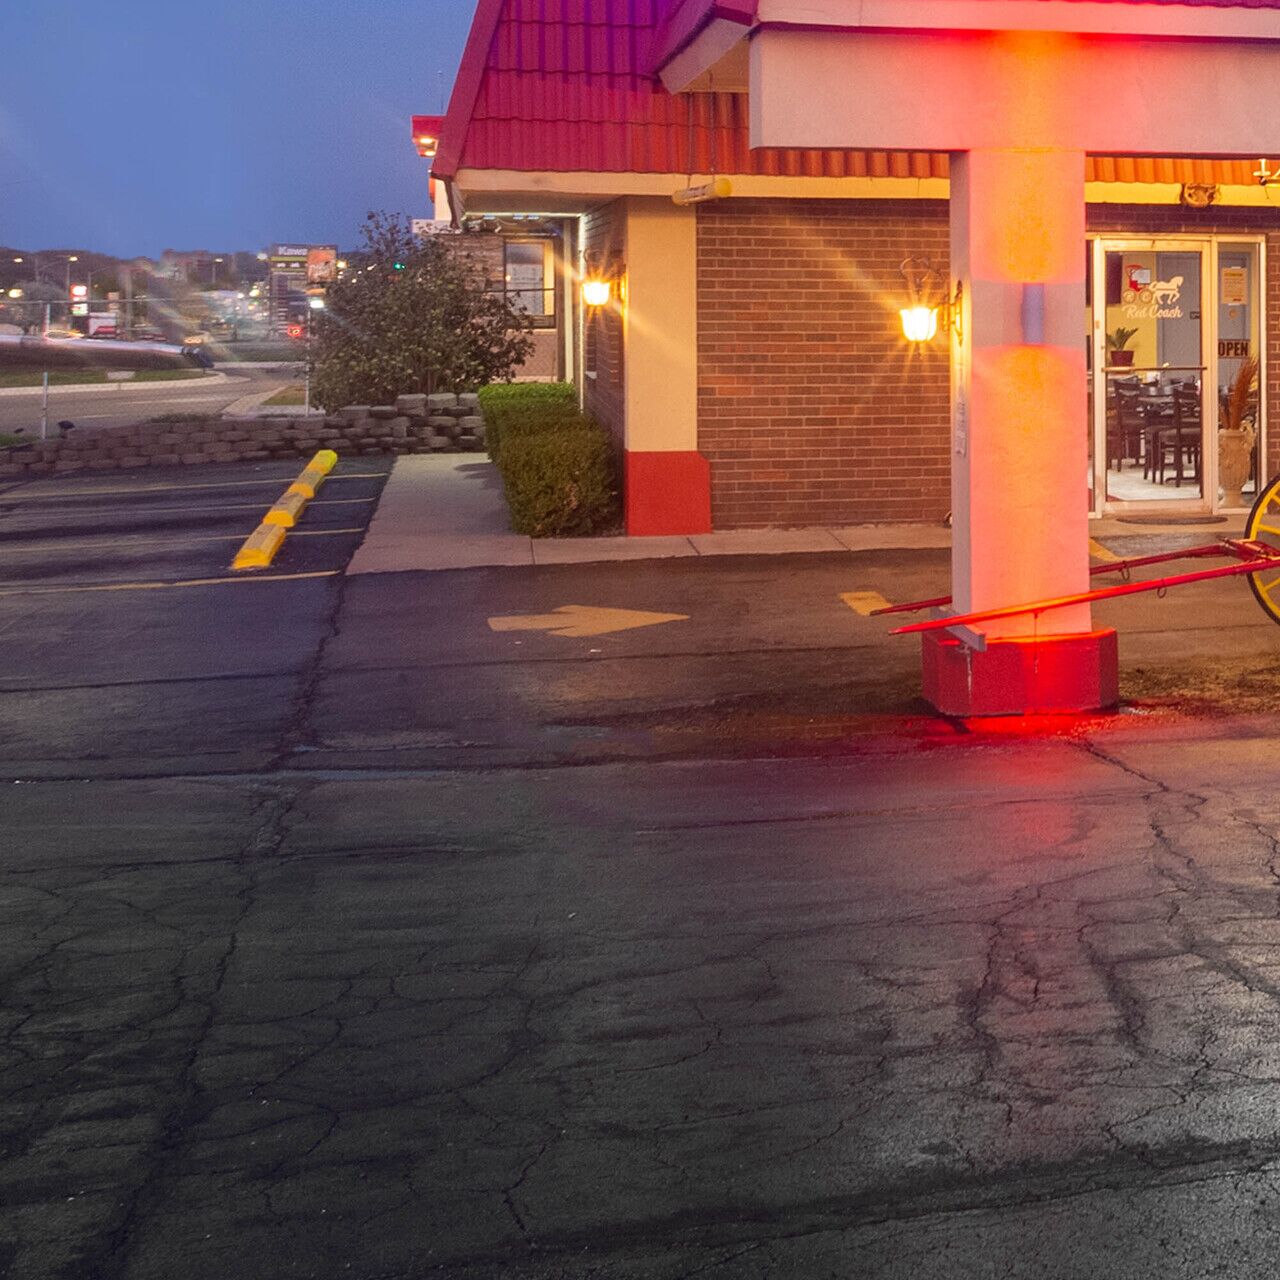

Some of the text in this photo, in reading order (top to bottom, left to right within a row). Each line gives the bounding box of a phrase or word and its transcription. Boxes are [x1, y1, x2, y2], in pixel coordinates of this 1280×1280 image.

[1121, 304, 1148, 319] Red
[1148, 304, 1184, 319] Coach
[1218, 342, 1249, 357] OPEN
